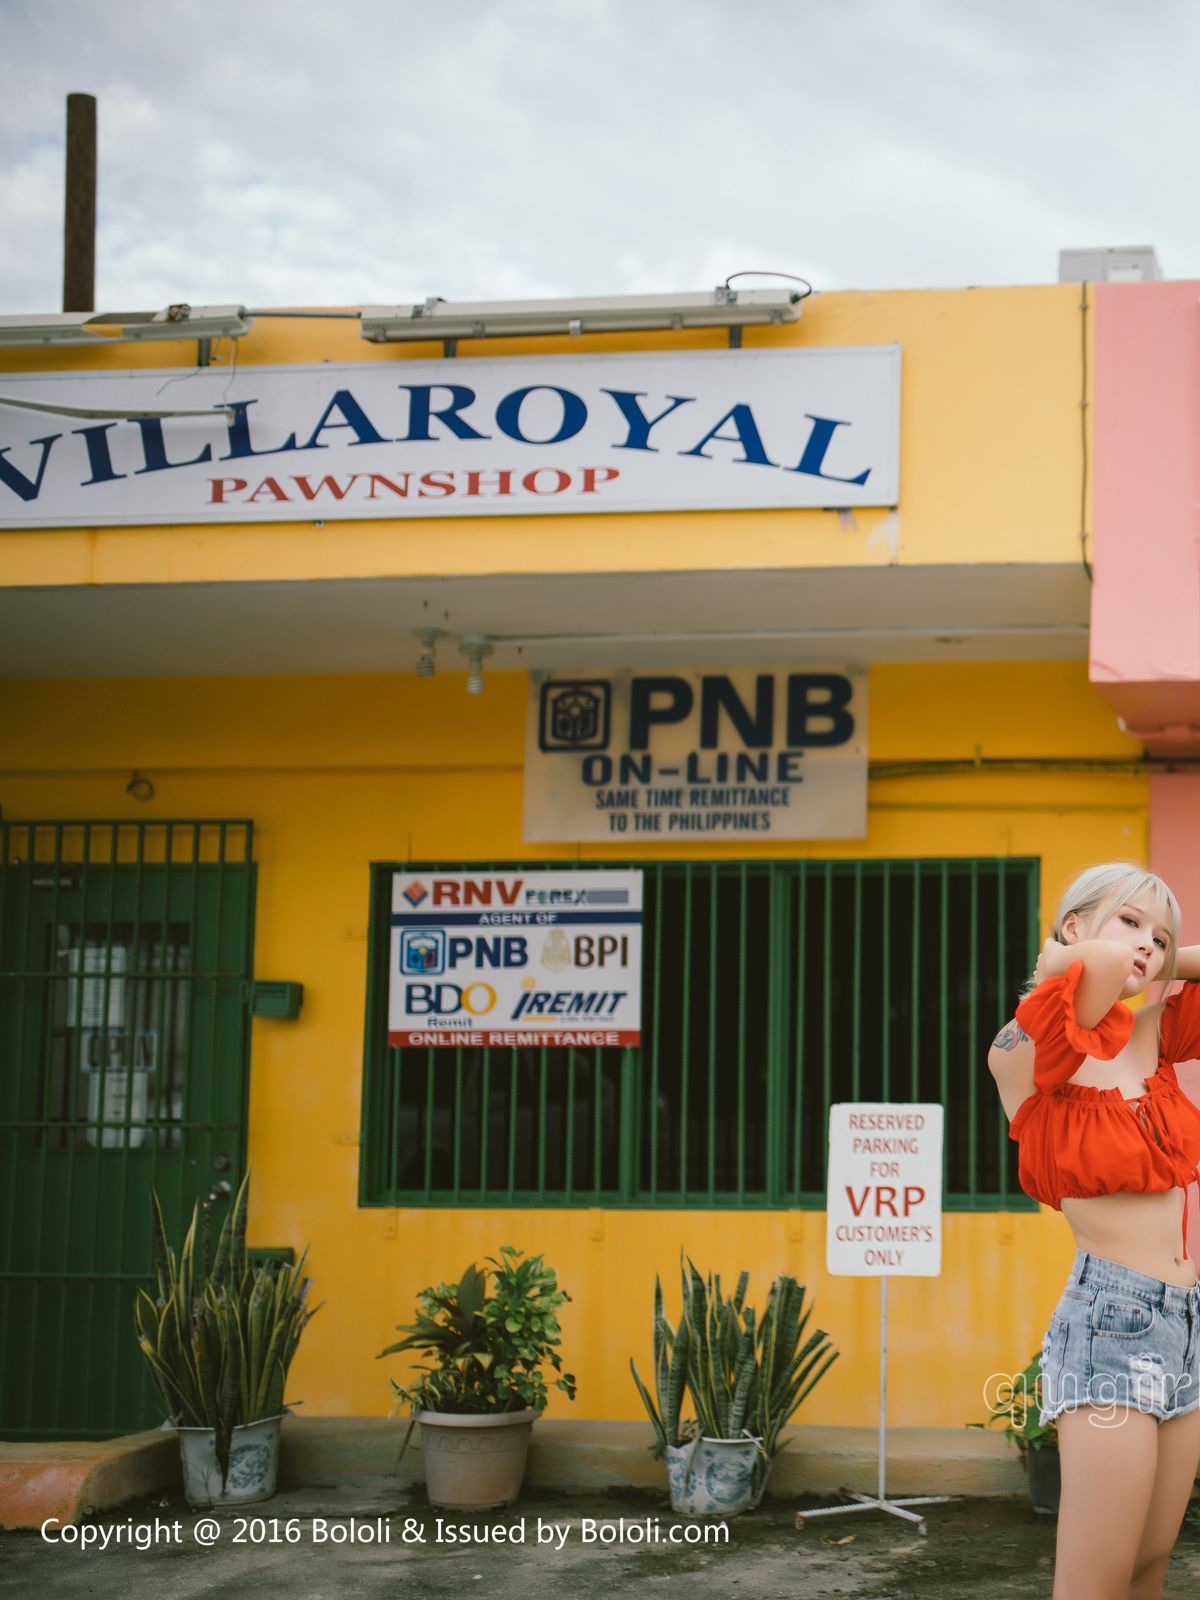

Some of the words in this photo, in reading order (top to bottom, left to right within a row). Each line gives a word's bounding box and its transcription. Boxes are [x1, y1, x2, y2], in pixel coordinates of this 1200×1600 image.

[0, 383, 873, 501] VILLAROYAL
[205, 466, 620, 505] PAWNSHOP
[629, 672, 856, 750] PNB
[581, 751, 804, 787] ON-LINE
[595, 788, 639, 809] SAME
[646, 788, 684, 808] TIME
[690, 786, 790, 808] REMITTANCE
[608, 812, 628, 832] TO
[634, 812, 662, 832] THE
[669, 811, 771, 832] PHILIPPINES
[432, 879, 524, 907] RNV
[479, 912, 531, 926] AGENT
[536, 912, 558, 925] OF
[448, 935, 529, 970] PNB
[573, 934, 629, 969] BPI
[404, 981, 497, 1016] BDO
[409, 1032, 483, 1046] ONLINE
[489, 1031, 620, 1046] REMITTANCE
[848, 1113, 925, 1131] RESERVED
[852, 1137, 919, 1154] PARKING
[869, 1161, 900, 1178] FOR
[844, 1185, 926, 1217] VRP
[835, 1225, 934, 1242] CUSTOMER'S
[863, 1249, 905, 1266] ONLY
